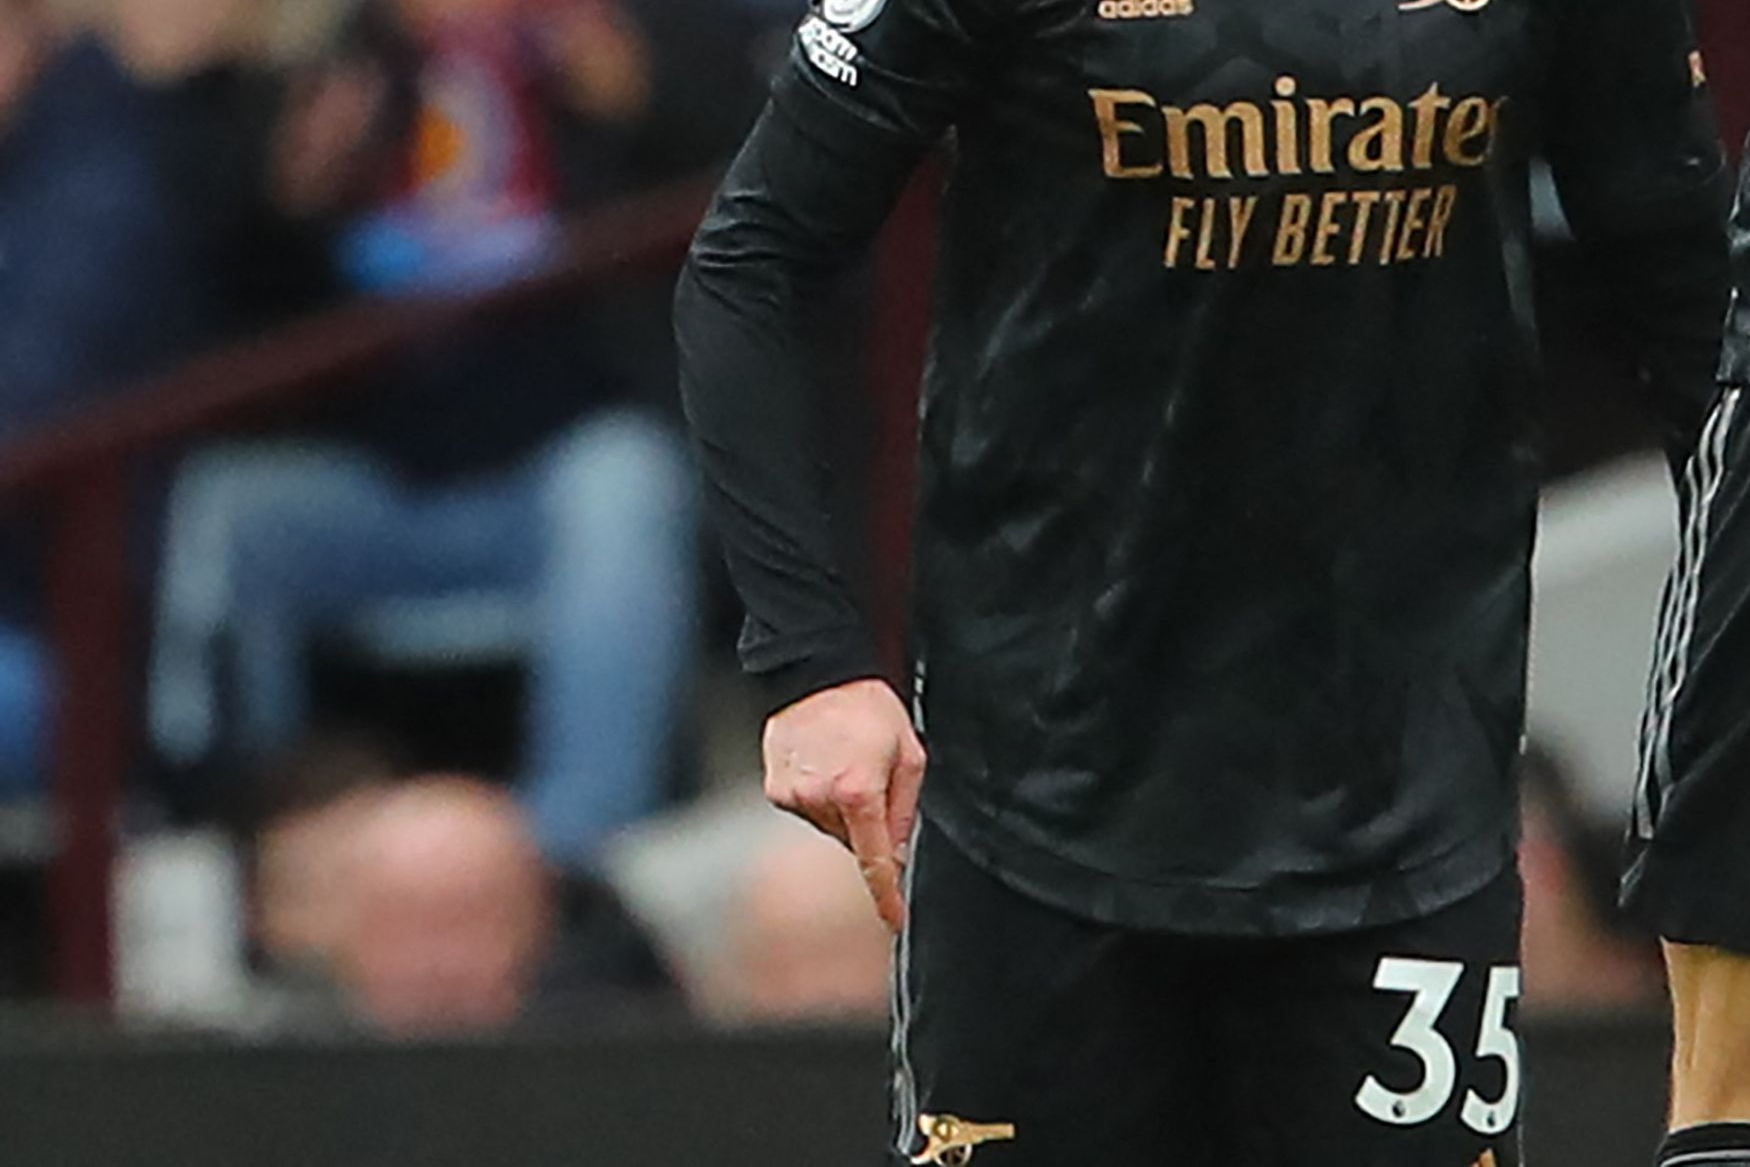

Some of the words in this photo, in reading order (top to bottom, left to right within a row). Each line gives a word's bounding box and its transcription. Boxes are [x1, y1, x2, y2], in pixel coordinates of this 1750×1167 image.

[1088, 76, 1509, 179] Emirate
[1163, 195, 1258, 270] FLY
[1271, 184, 1458, 267] BETTER
[1355, 956, 1520, 1135] 35
